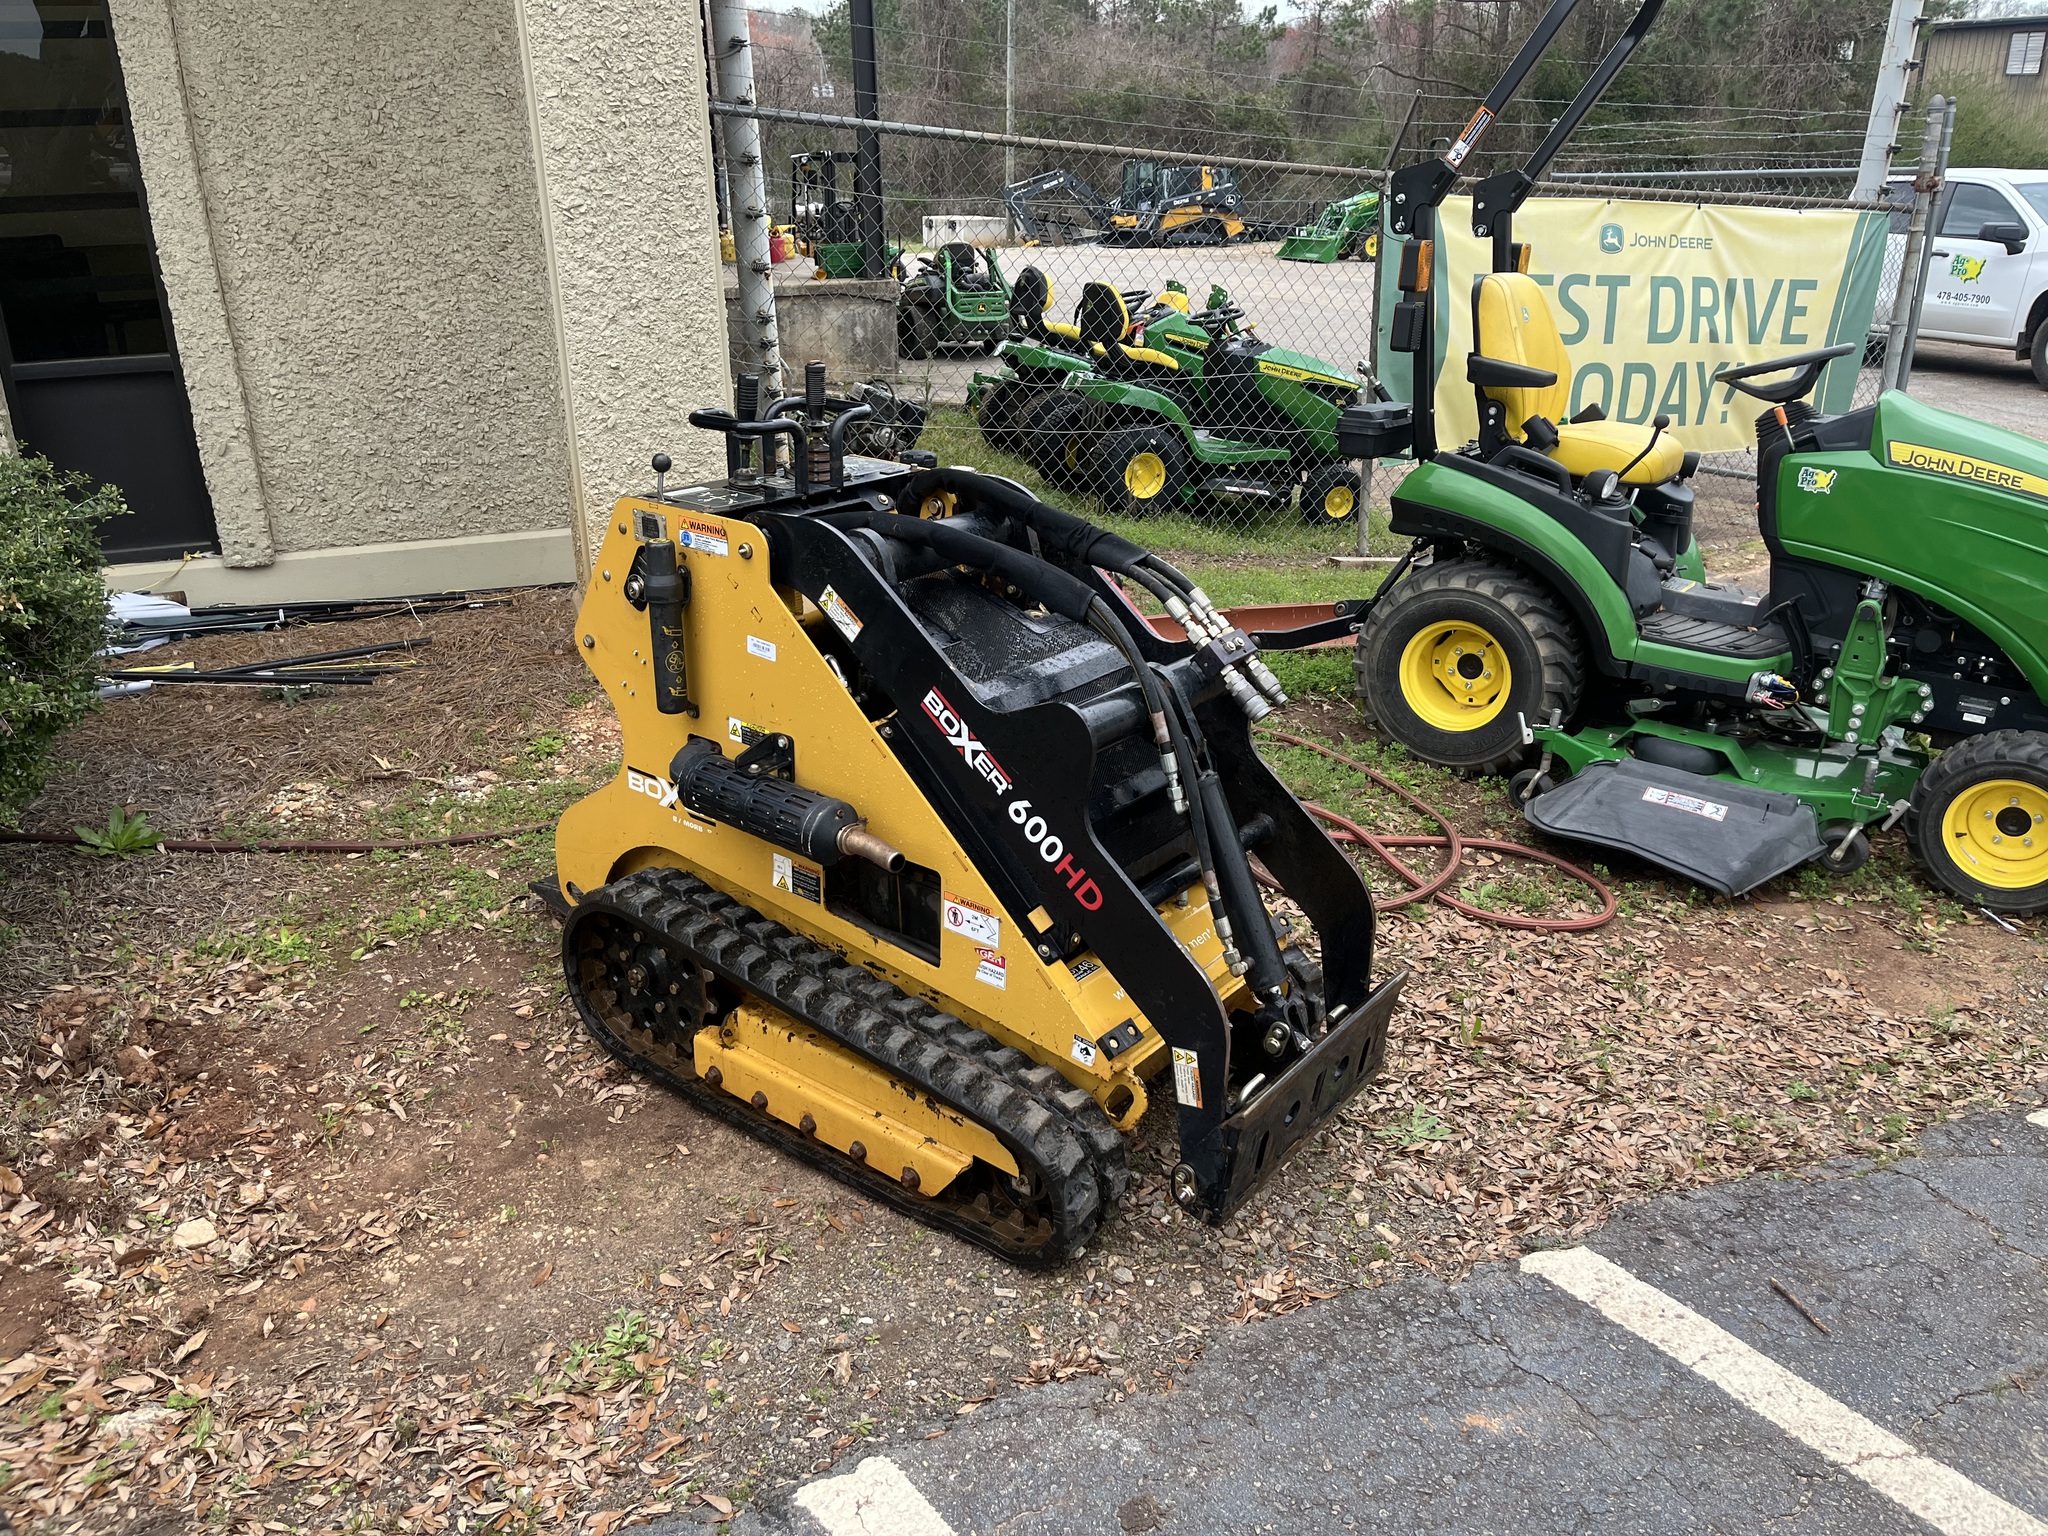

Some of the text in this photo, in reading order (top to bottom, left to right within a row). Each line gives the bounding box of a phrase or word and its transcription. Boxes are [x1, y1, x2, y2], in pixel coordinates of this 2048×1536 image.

[1629, 232, 1713, 250] JOHN DEERE
[1950, 265, 1968, 276] Pro
[1936, 291, 1991, 305] 478-405-7900
[1646, 275, 1818, 345] DRIVE
[1263, 364, 1281, 373] JOHN
[1569, 361, 1746, 428] ODAY!
[1901, 450, 2024, 488] JOHN DEERE
[1799, 476, 1817, 485] Pro
[688, 520, 727, 537] WARNING
[923, 689, 1103, 911] BOXER 600HD
[960, 898, 991, 915] WARNING
